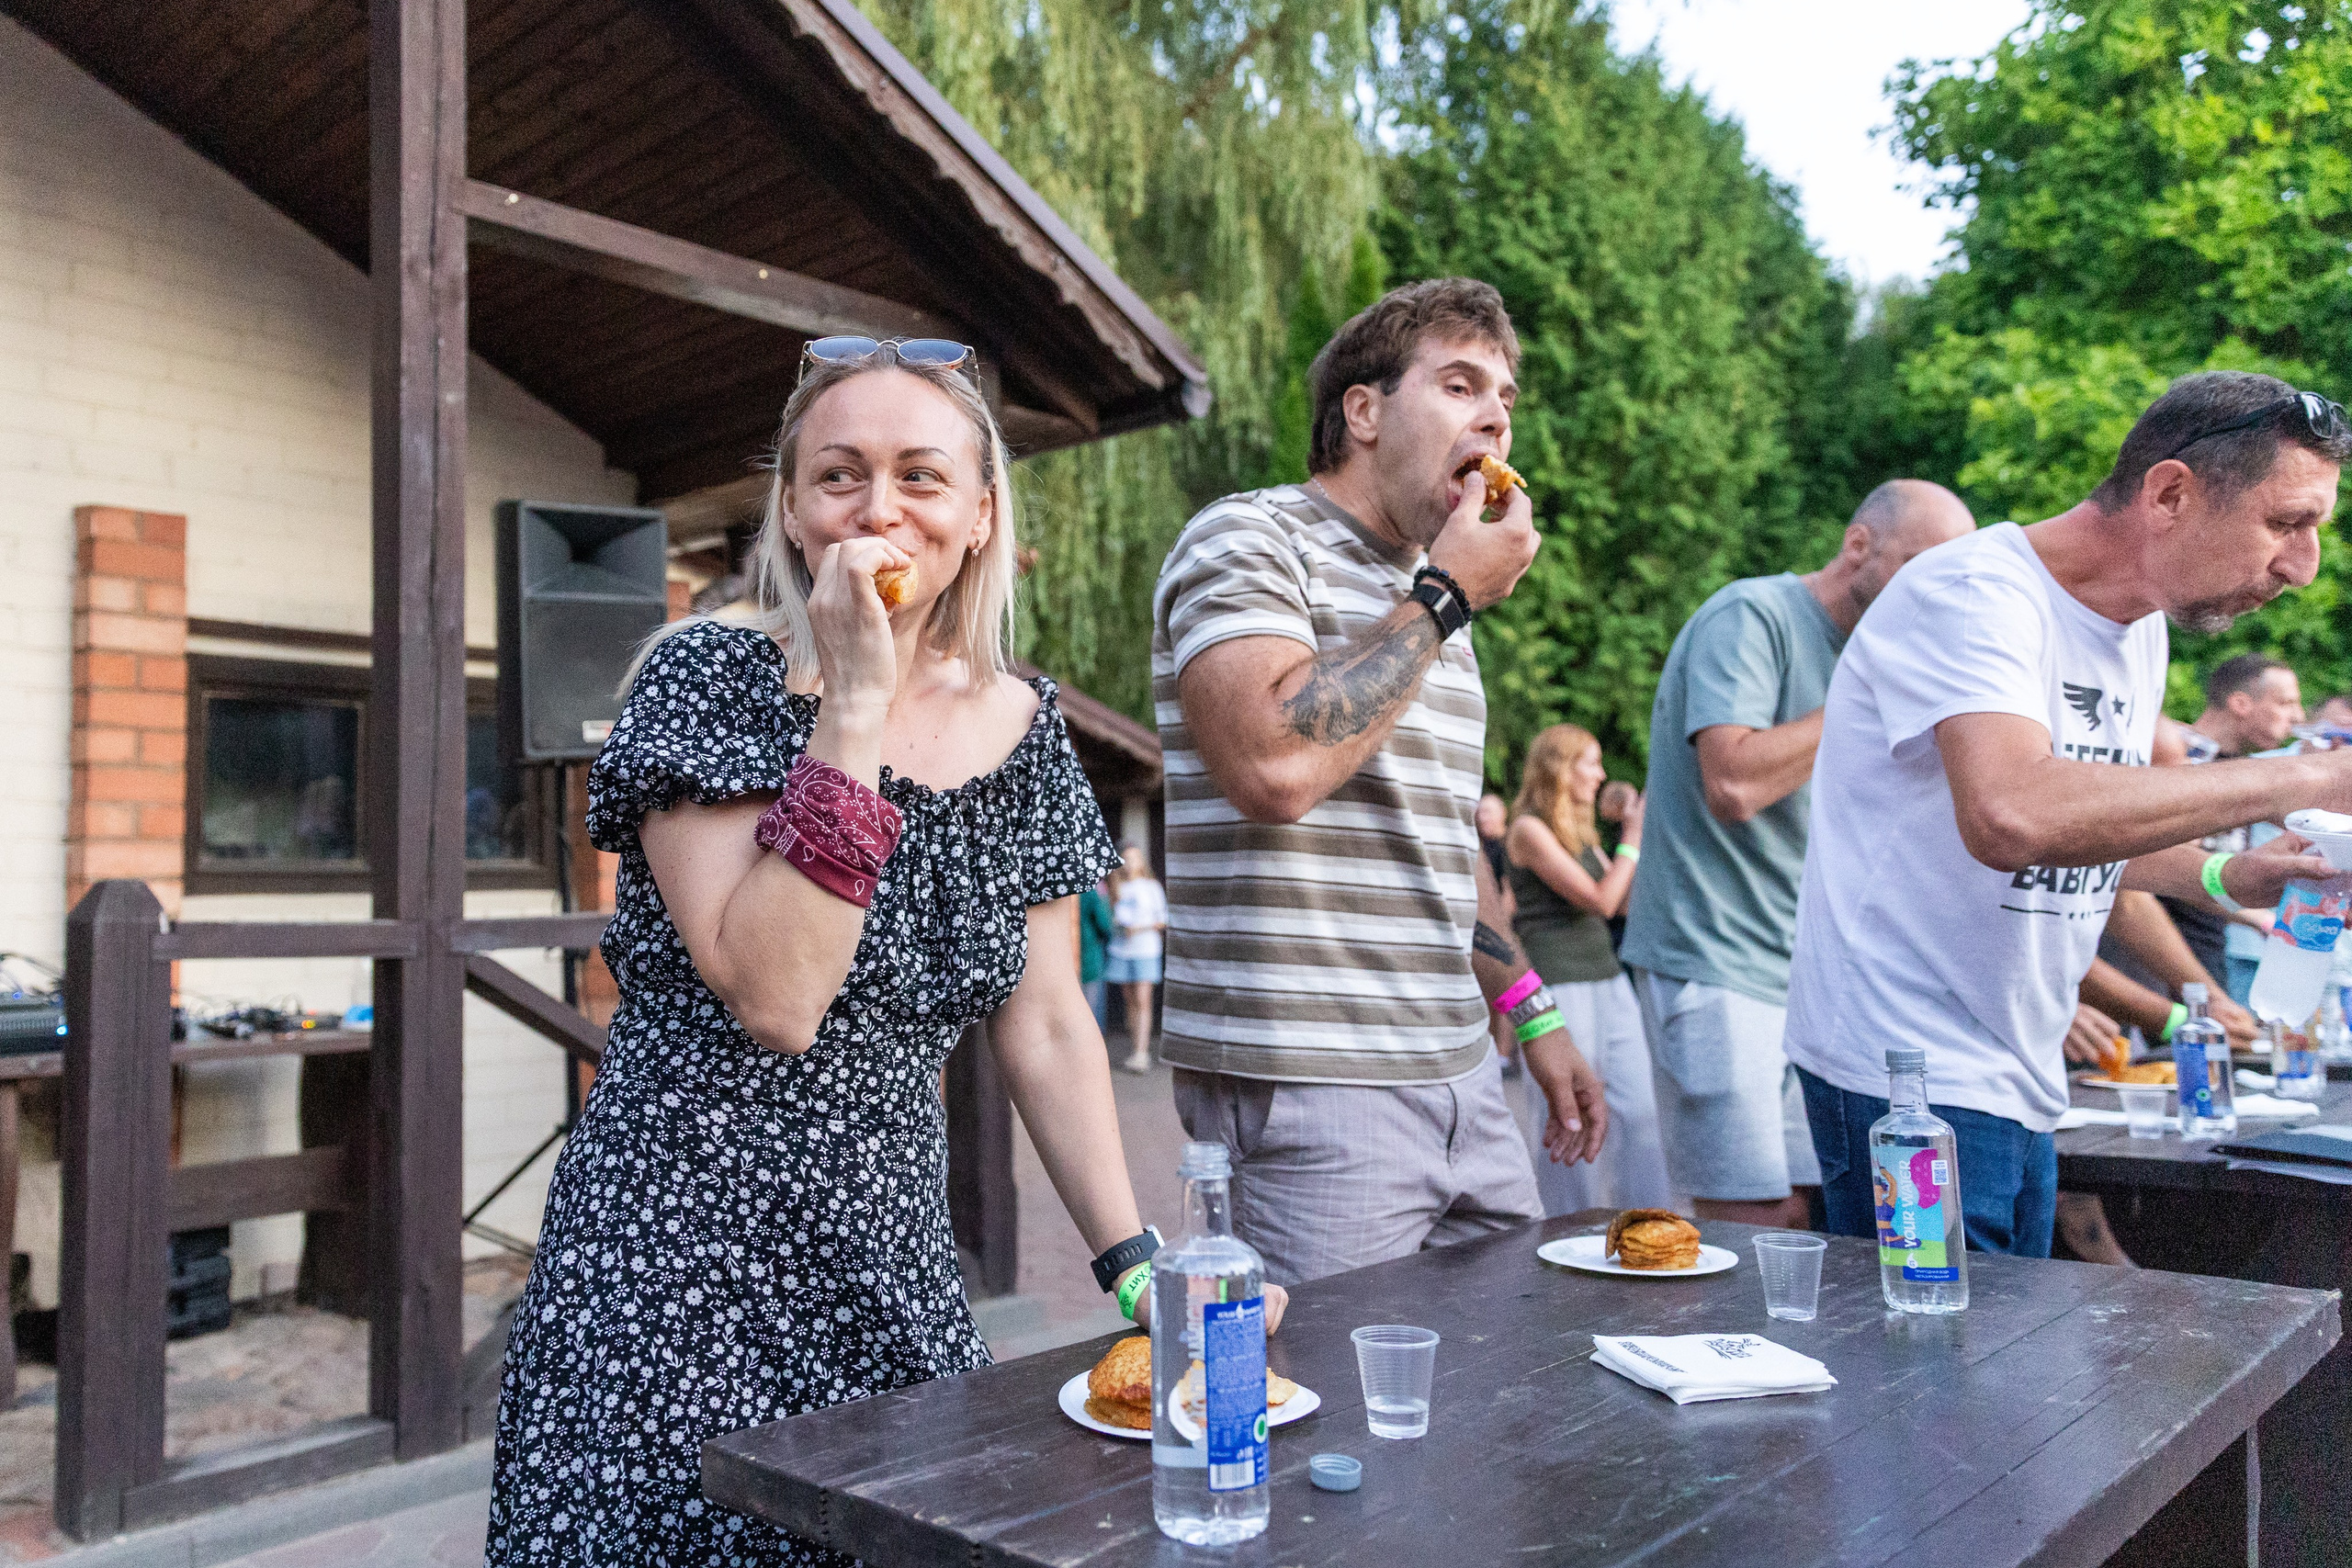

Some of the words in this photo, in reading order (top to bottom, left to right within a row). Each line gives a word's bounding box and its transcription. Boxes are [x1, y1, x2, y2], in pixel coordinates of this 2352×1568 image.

[1898, 1159, 1914, 1208] WATER
[1904, 1210, 1917, 1248] YOUR
[1128, 1270, 1149, 1292] ХИТ
